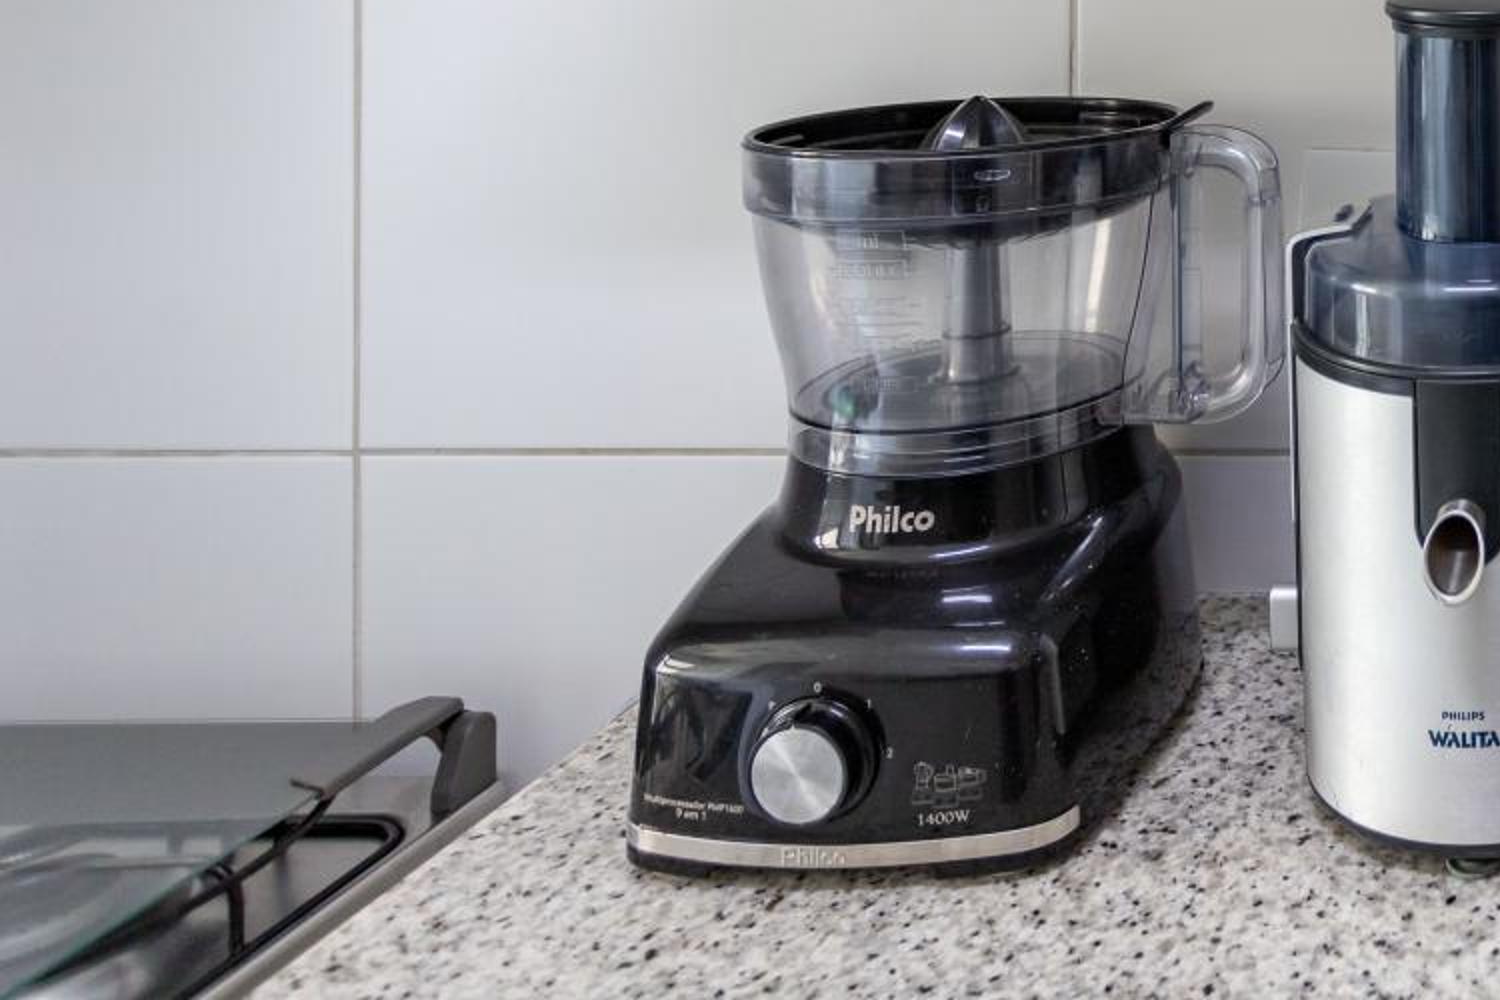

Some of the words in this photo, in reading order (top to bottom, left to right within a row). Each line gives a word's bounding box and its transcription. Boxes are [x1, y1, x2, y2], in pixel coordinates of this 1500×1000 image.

[849, 504, 935, 533] Philco
[1441, 711, 1486, 721] PHILIPS
[917, 810, 970, 827] 1400W
